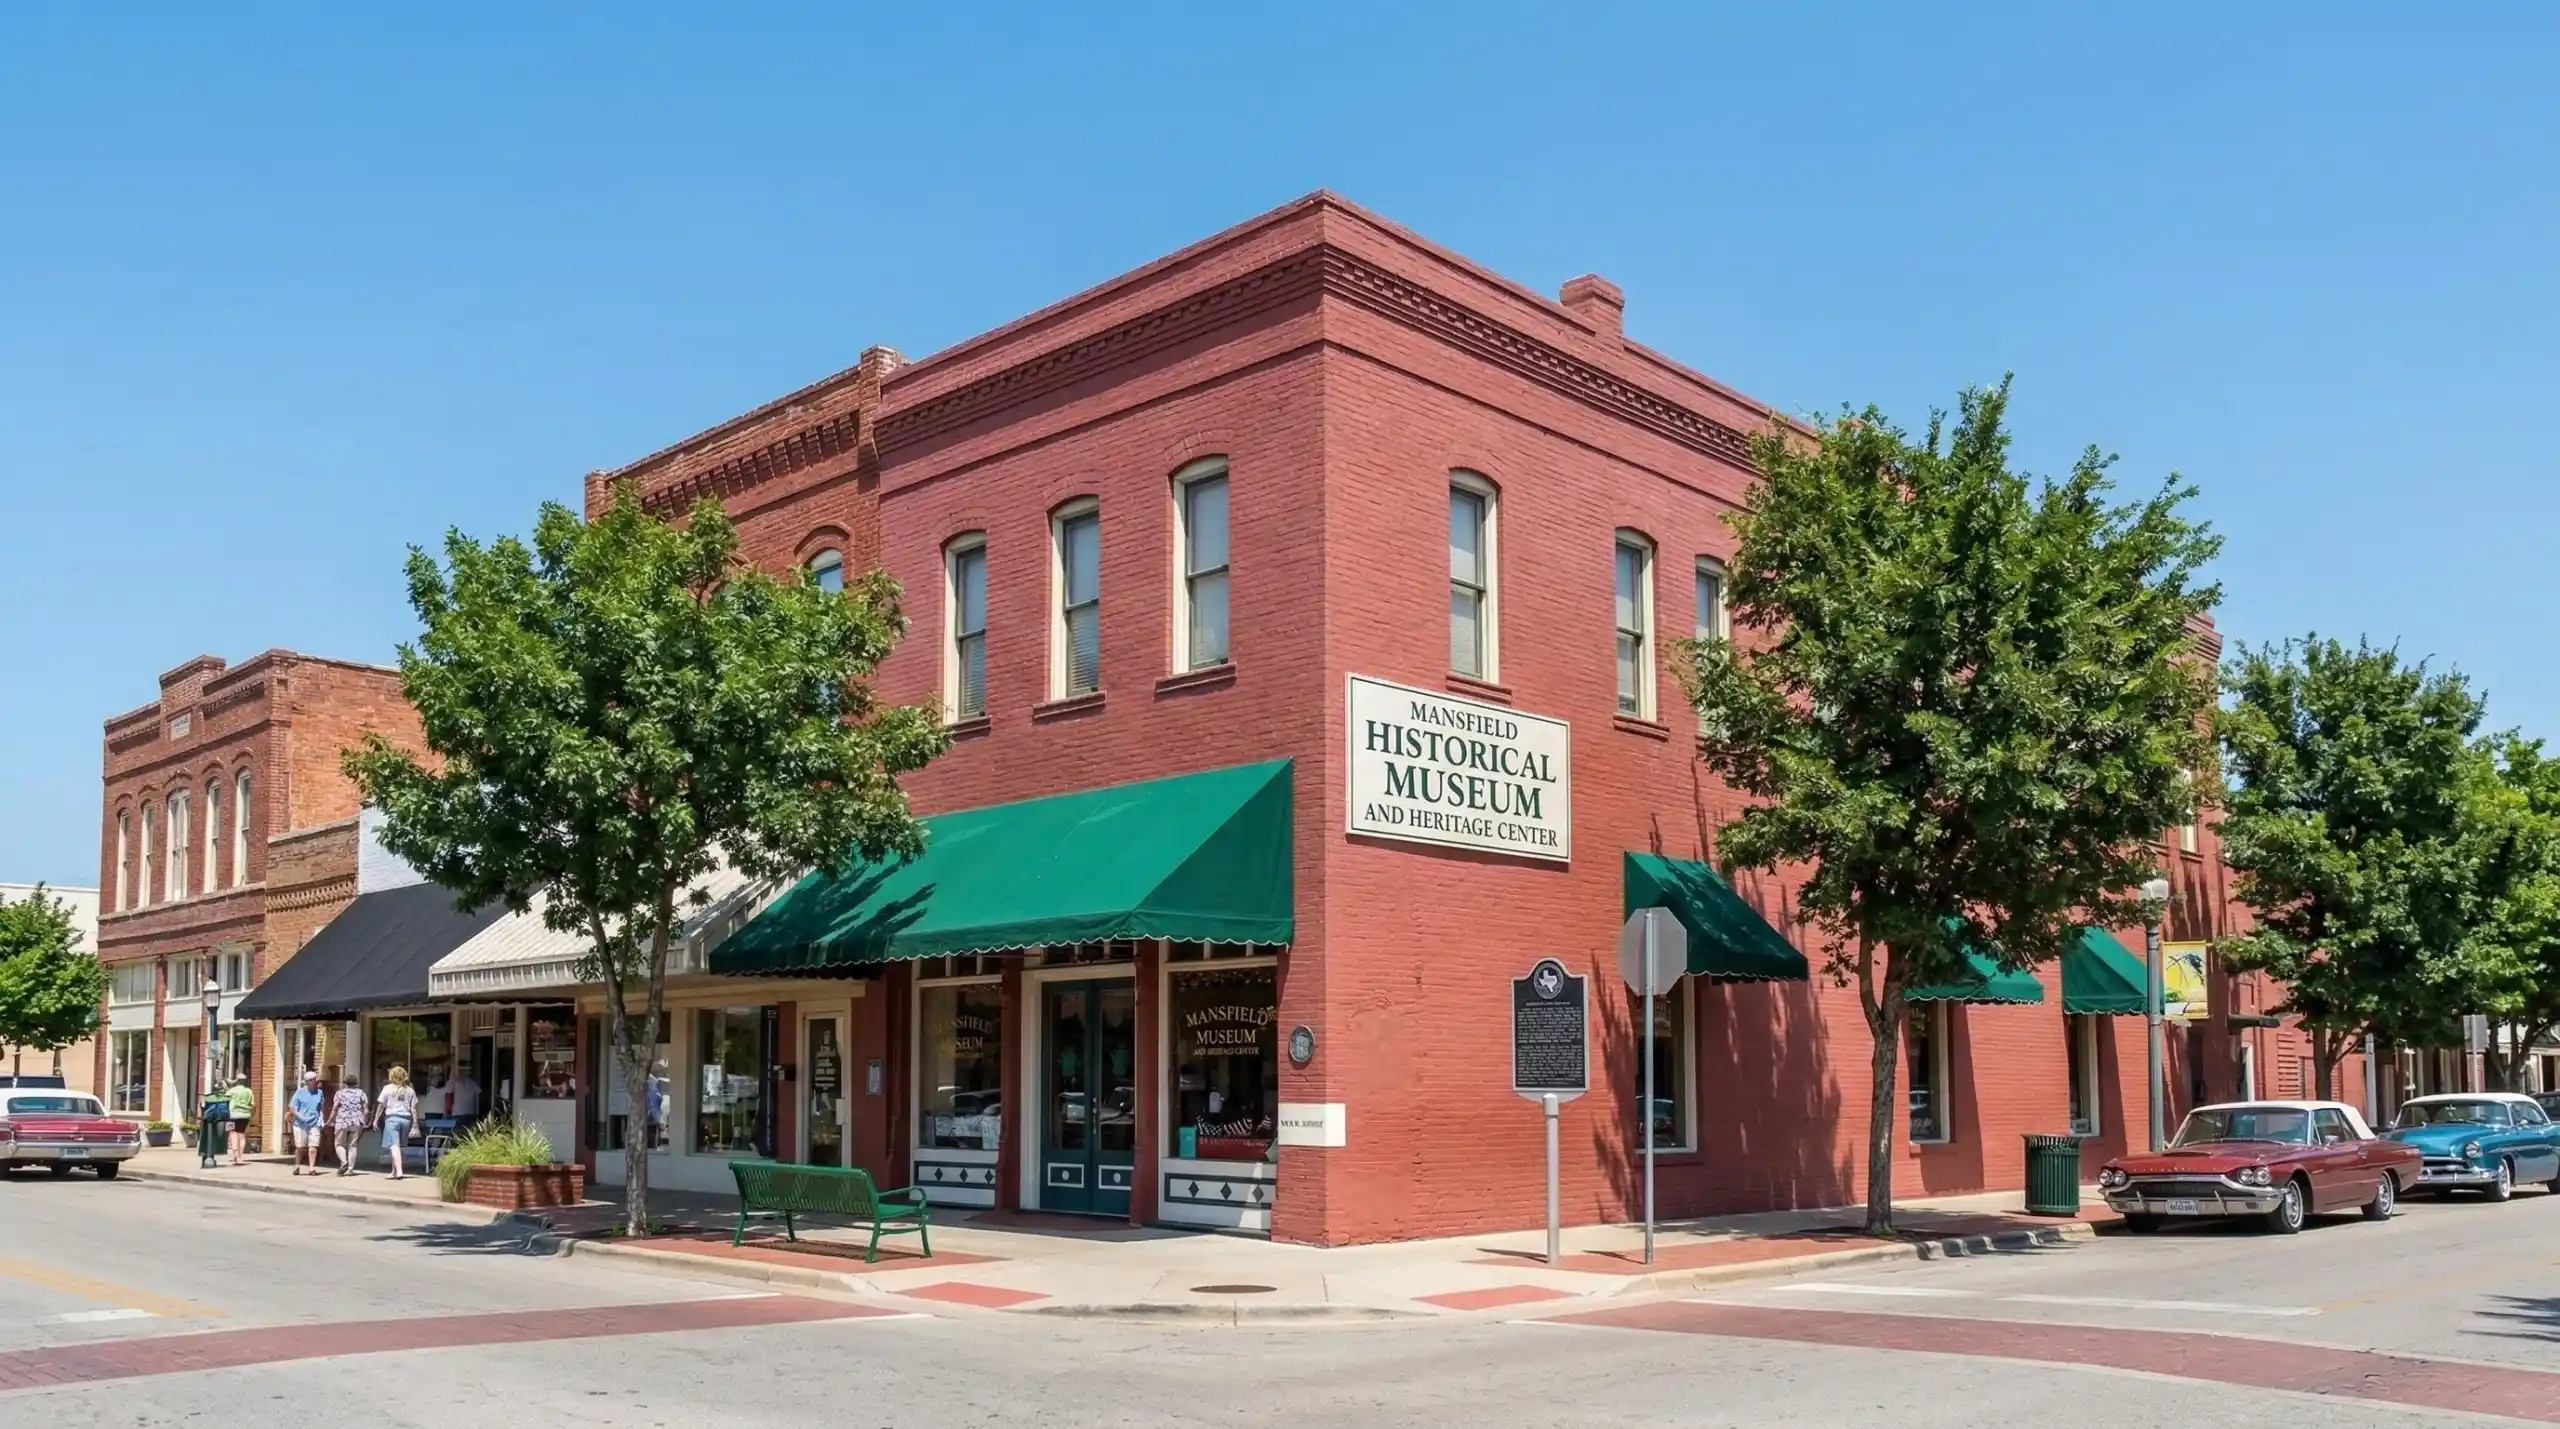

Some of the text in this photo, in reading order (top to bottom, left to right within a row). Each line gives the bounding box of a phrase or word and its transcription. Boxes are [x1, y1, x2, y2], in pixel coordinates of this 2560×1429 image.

[1410, 701, 1518, 741] MANSFIELD
[1365, 719, 1557, 784] HISTORICAL
[1384, 761, 1543, 820] MUSEUM
[1364, 802, 1558, 847] AND HERITAGE CENTER
[1185, 1005, 1268, 1028] MANSFIELD
[1196, 1029, 1257, 1045] MUSEUM
